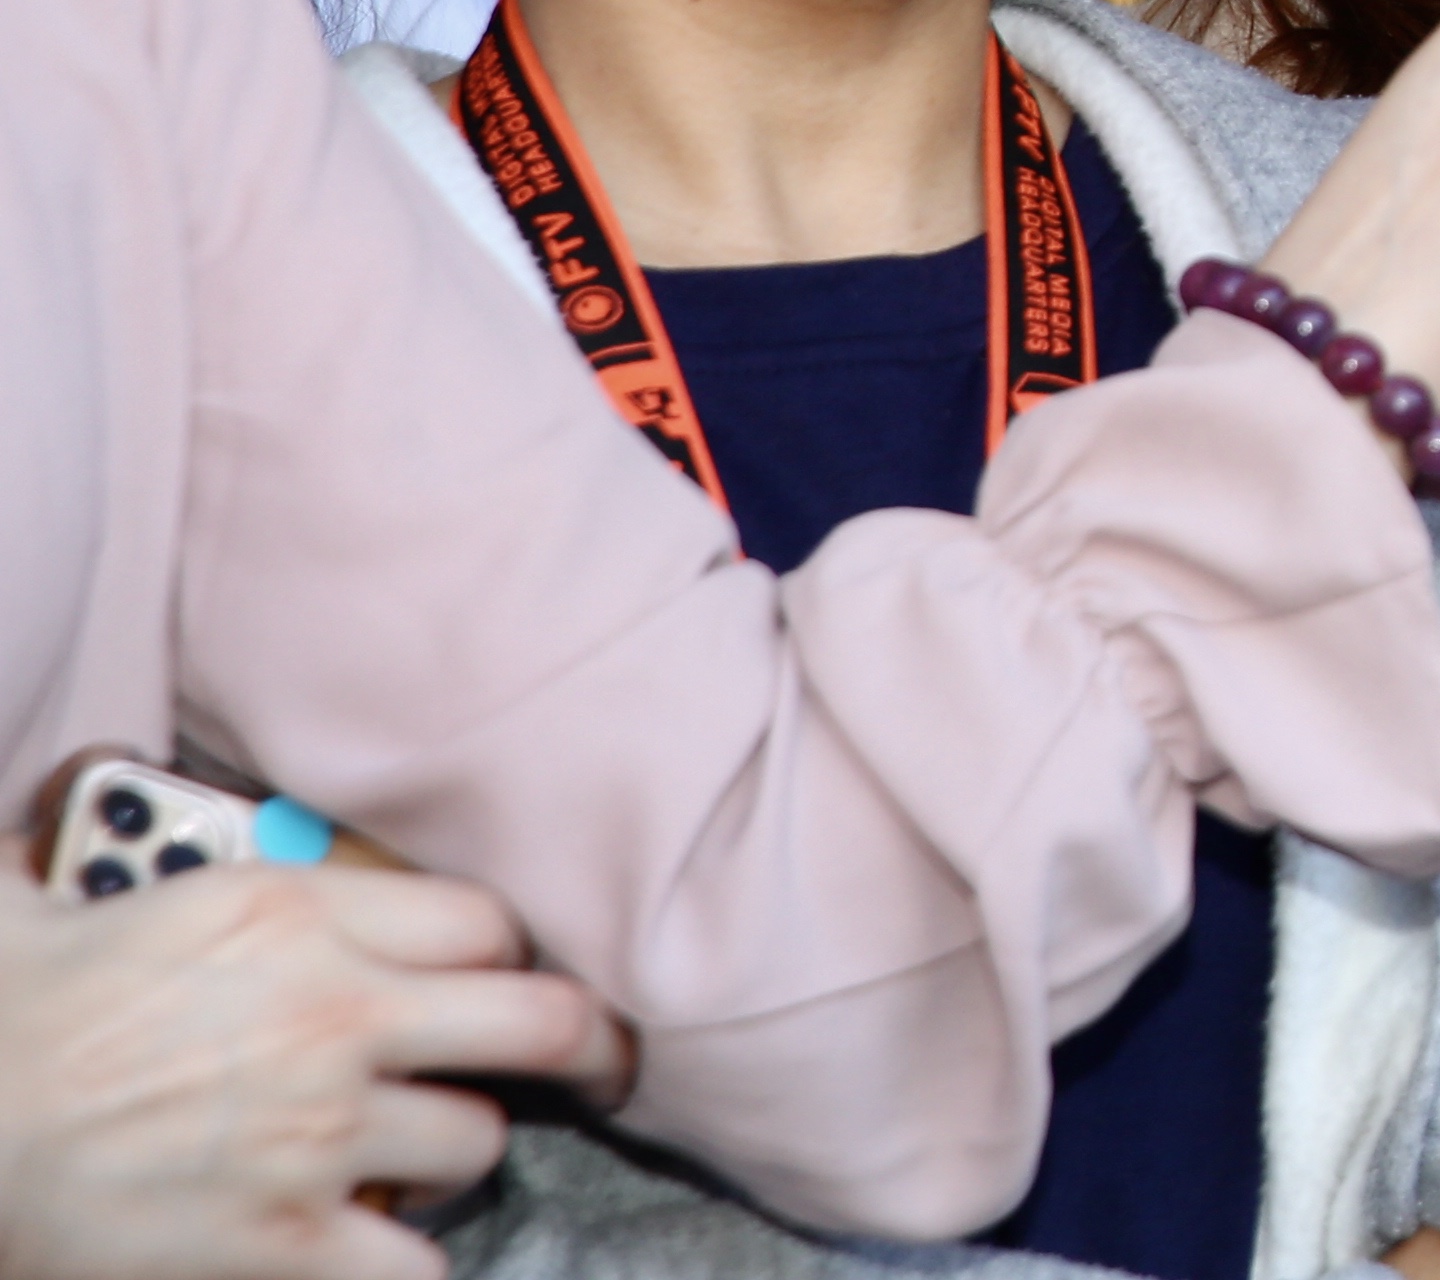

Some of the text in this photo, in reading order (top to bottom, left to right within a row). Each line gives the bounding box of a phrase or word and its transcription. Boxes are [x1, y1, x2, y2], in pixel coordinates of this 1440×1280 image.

[531, 211, 601, 289] FTV
[1017, 166, 1050, 355] HEADQUARTERS
[1039, 175, 1073, 357] DIGITAL MEDIA
